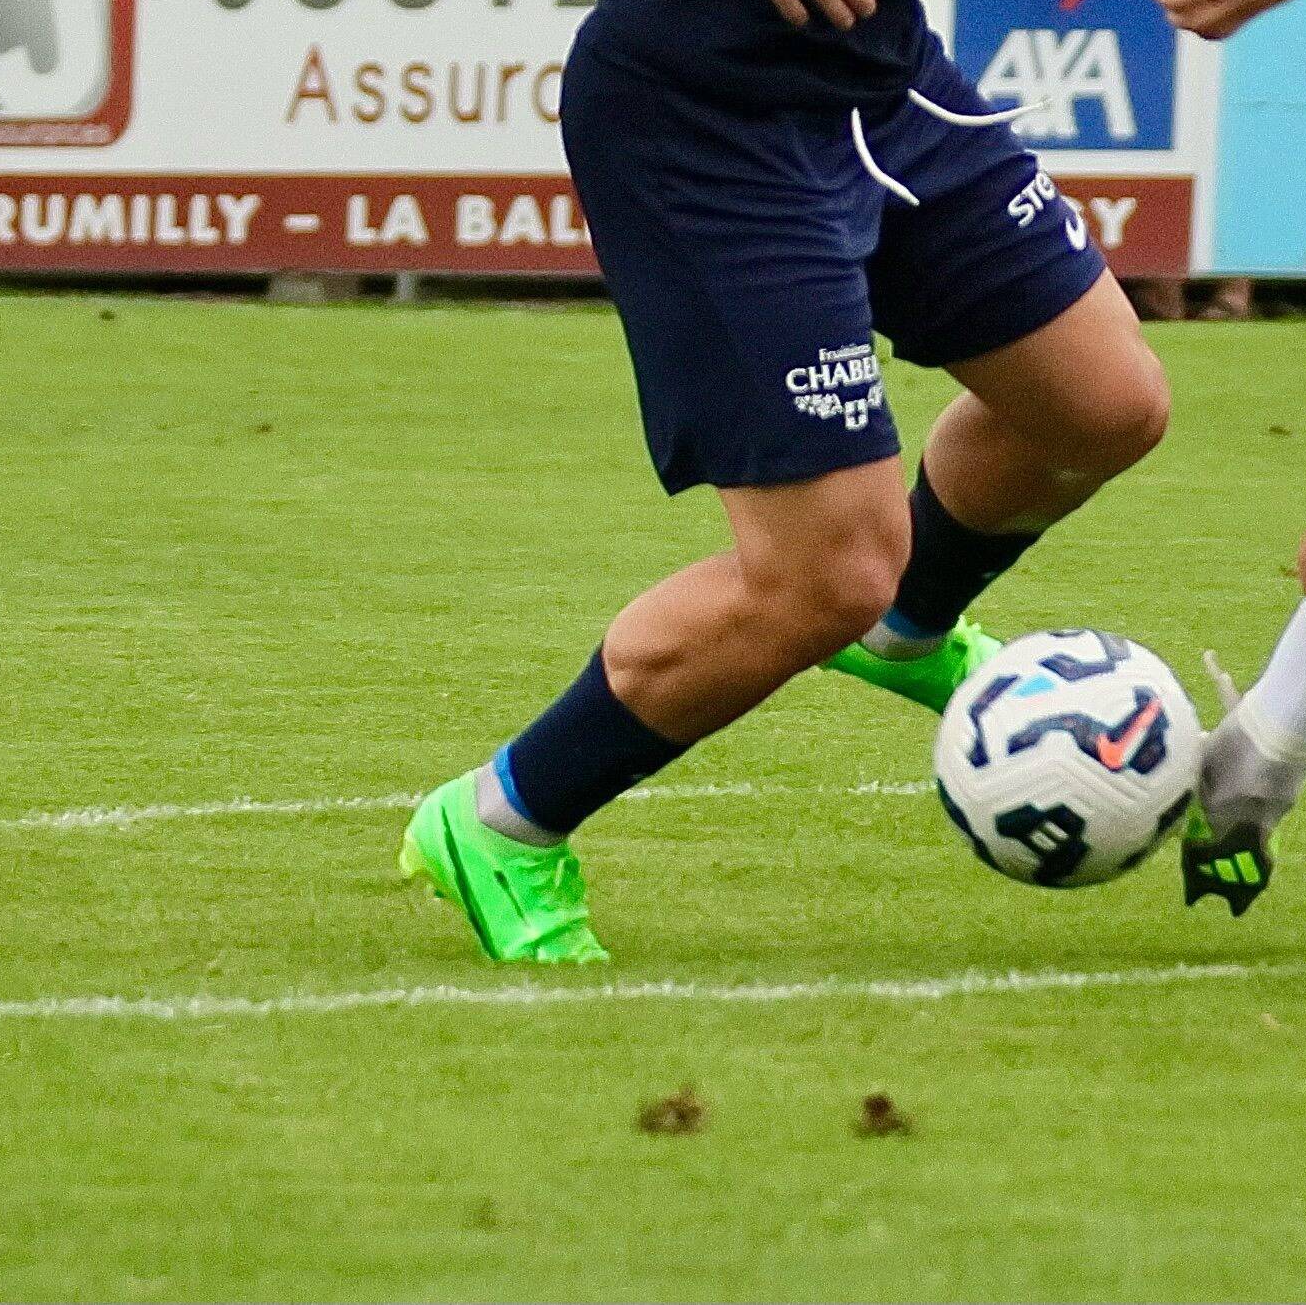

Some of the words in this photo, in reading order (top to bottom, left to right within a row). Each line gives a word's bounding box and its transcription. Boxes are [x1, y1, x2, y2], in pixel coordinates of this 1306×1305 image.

[977, 28, 1138, 141] AXA
[345, 193, 429, 246] LA
[455, 193, 592, 248] BAL
